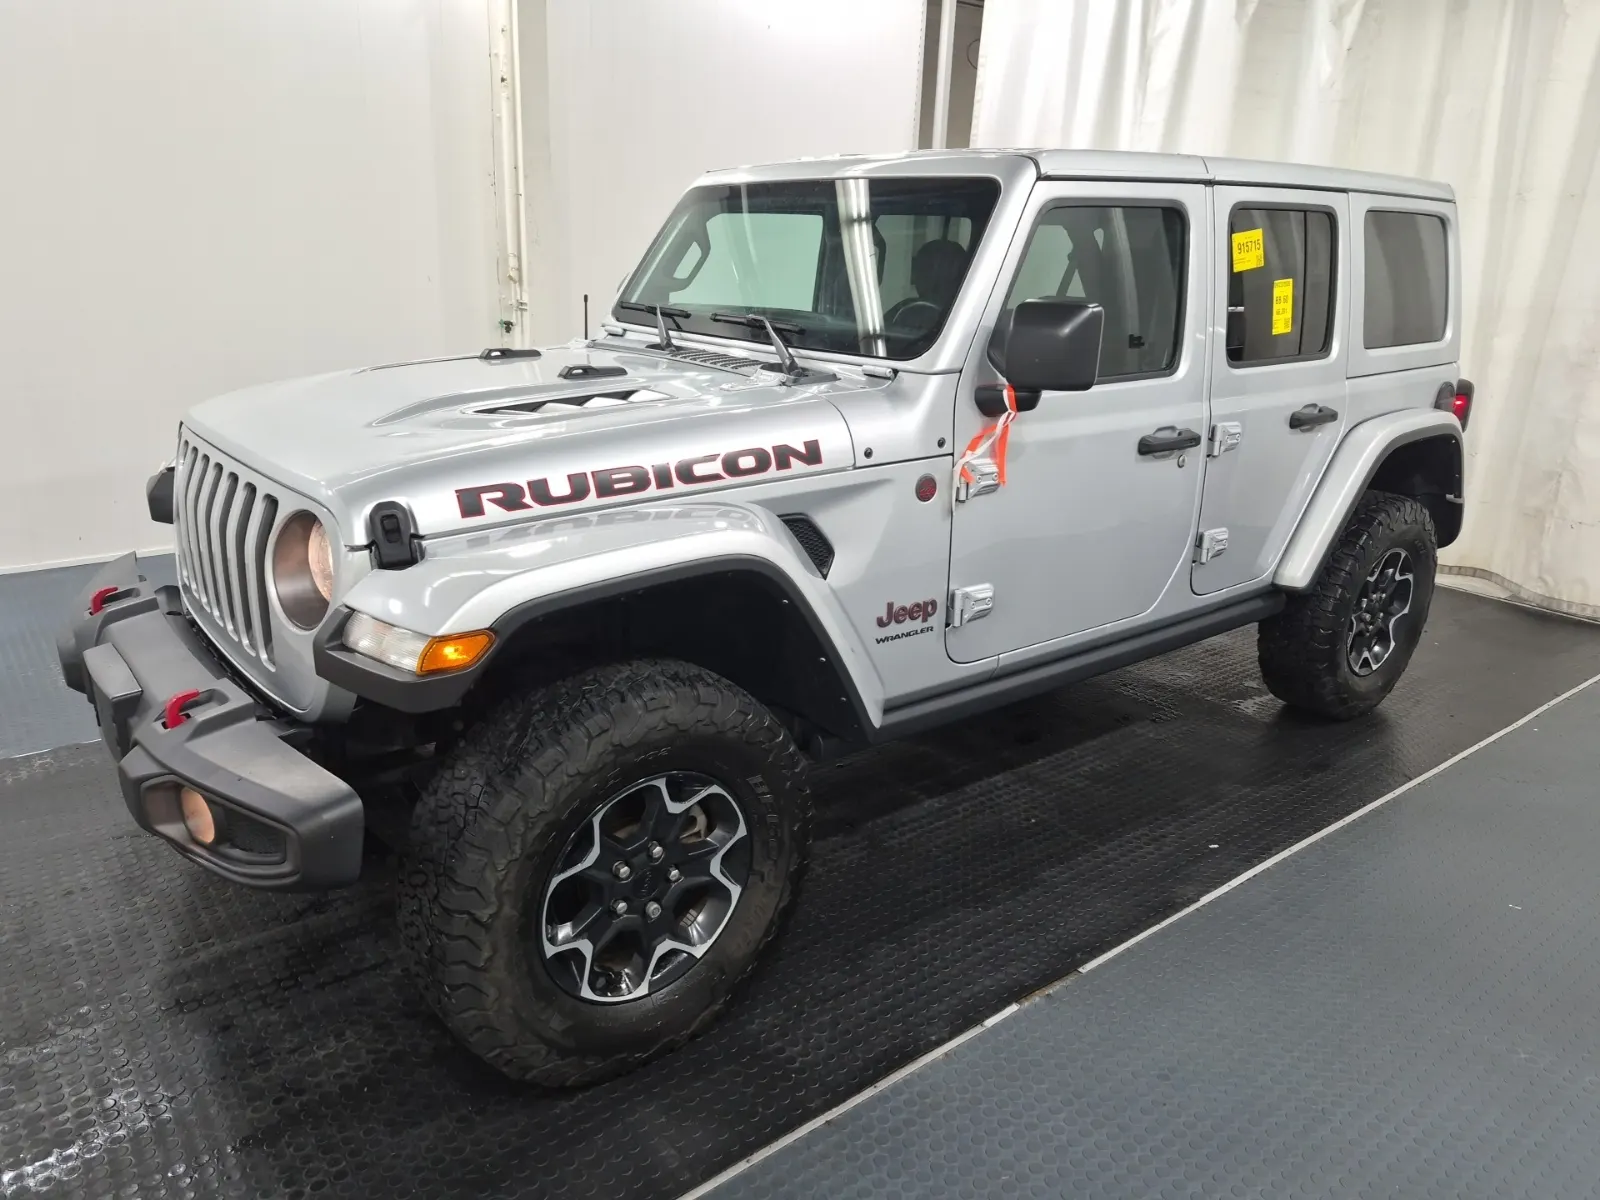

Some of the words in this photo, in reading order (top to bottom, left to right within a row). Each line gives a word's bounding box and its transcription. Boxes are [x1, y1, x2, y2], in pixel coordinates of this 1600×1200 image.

[1237, 239, 1261, 255] 915715
[455, 439, 823, 519] RUBICON
[876, 598, 938, 628] Jeep
[875, 625, 934, 645] WRANGLER
